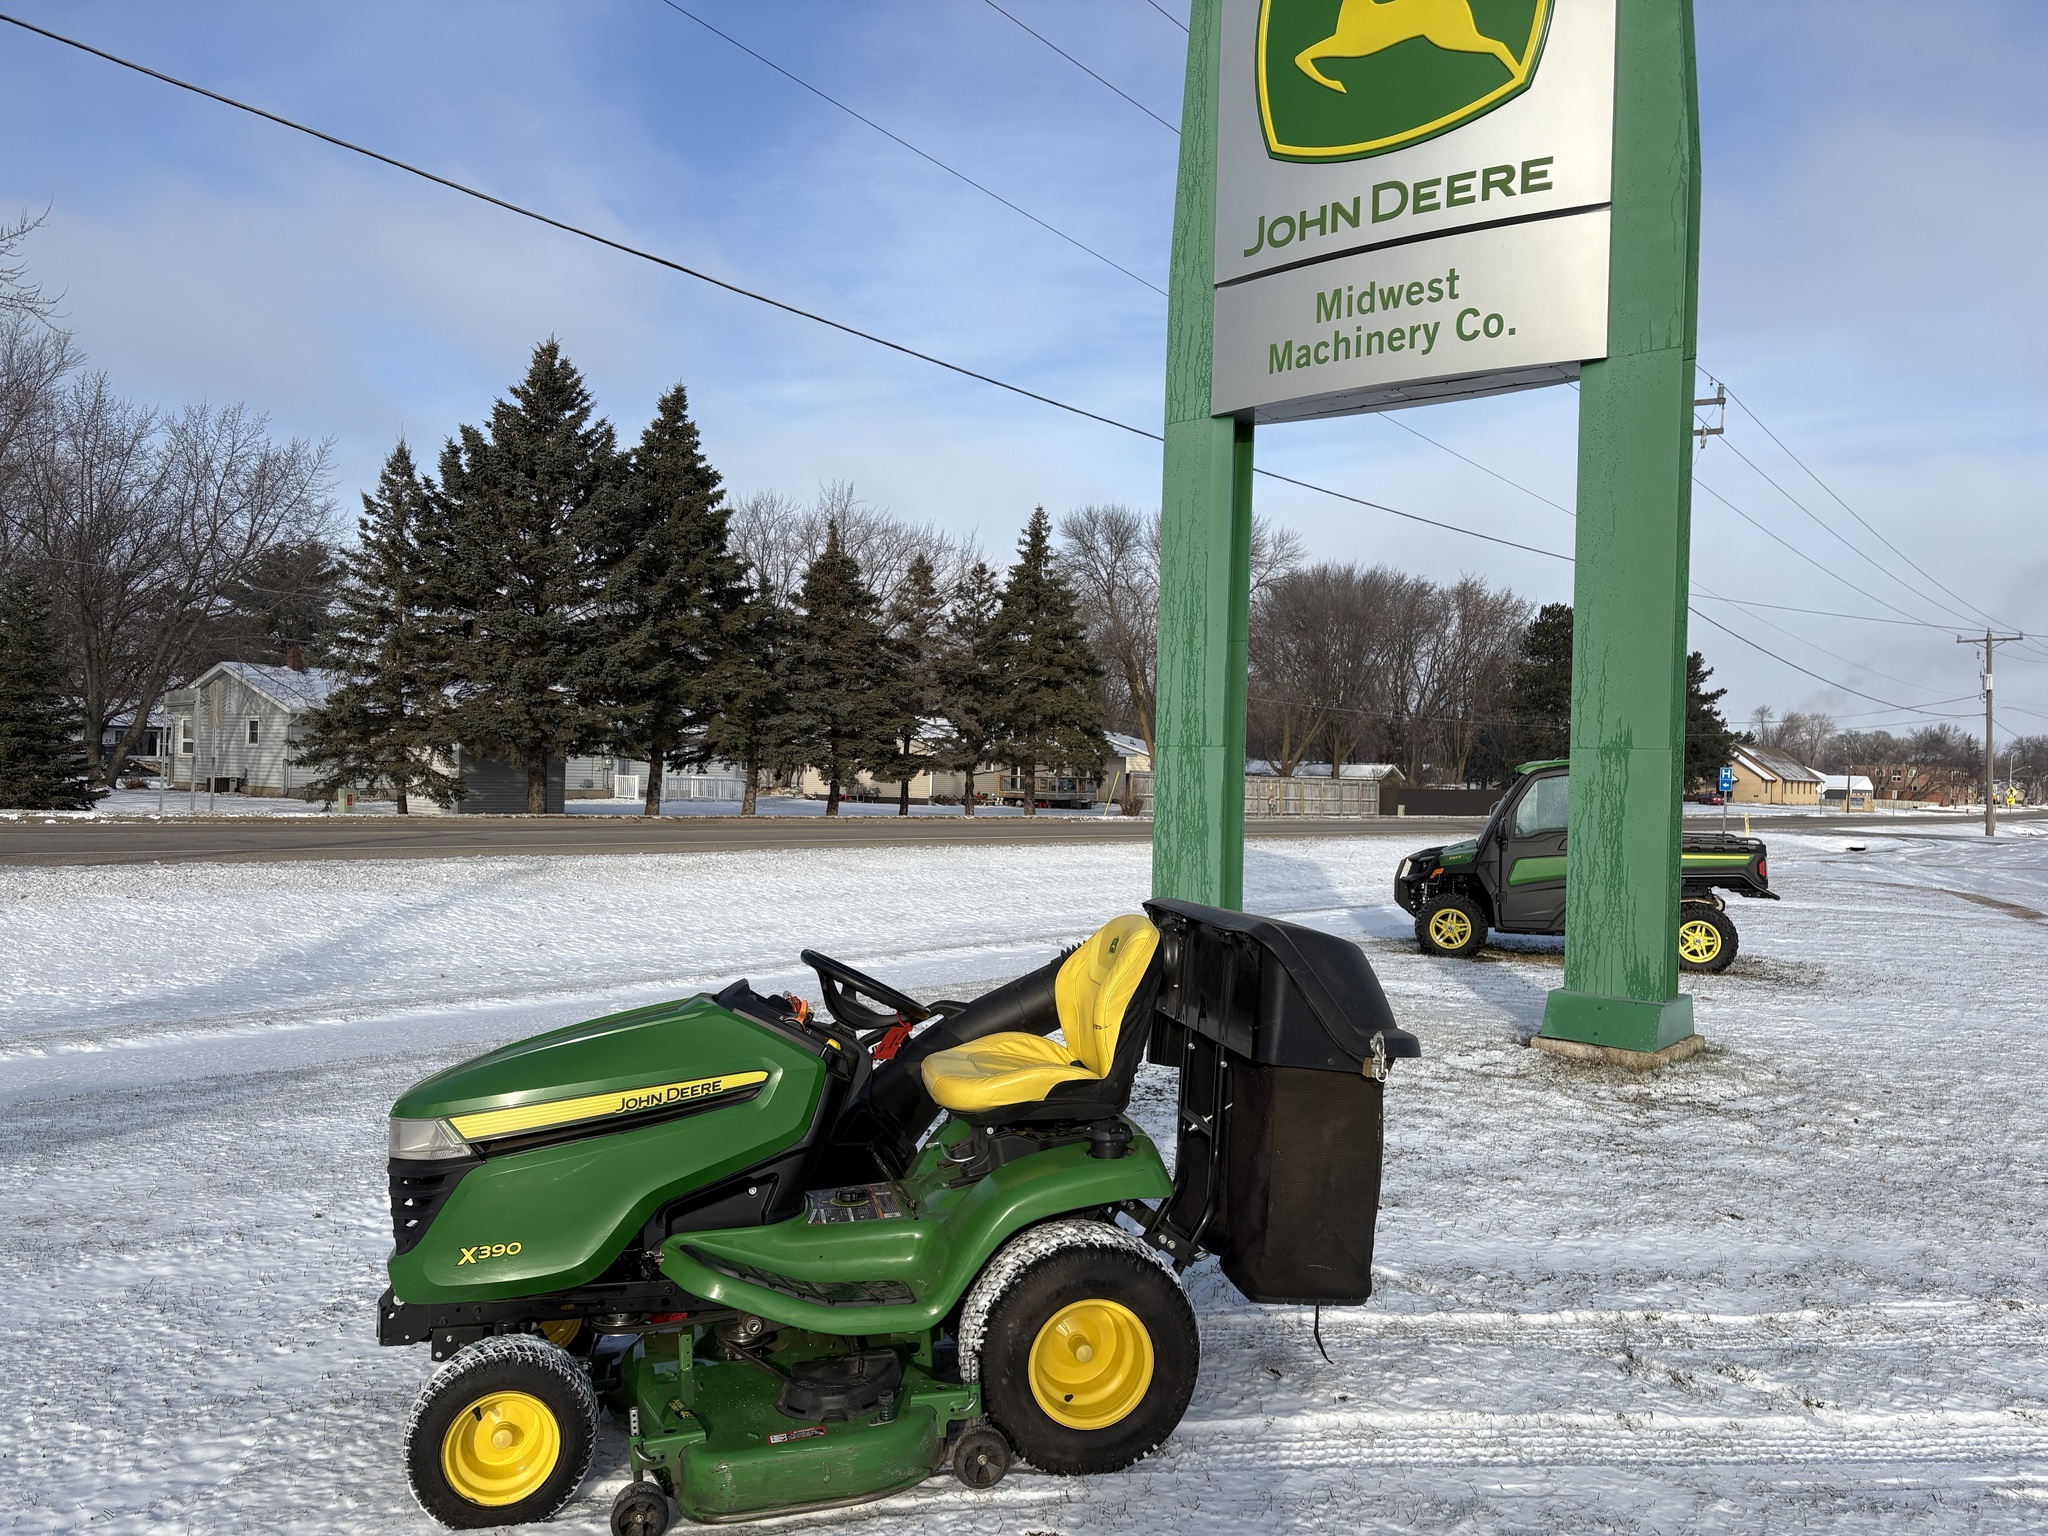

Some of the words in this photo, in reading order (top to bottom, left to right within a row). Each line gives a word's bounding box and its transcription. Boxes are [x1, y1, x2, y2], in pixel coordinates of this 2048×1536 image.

[1244, 196, 1361, 258] JOHN
[1371, 156, 1554, 224] DEERE
[1315, 268, 1460, 324] Midwest
[1268, 321, 1441, 375] Machinery
[1456, 307, 1517, 342] Co.
[1721, 769, 1731, 779] H
[615, 1092, 663, 1112] JOHN
[666, 1080, 722, 1101] DEERE
[455, 1240, 522, 1267] X390
